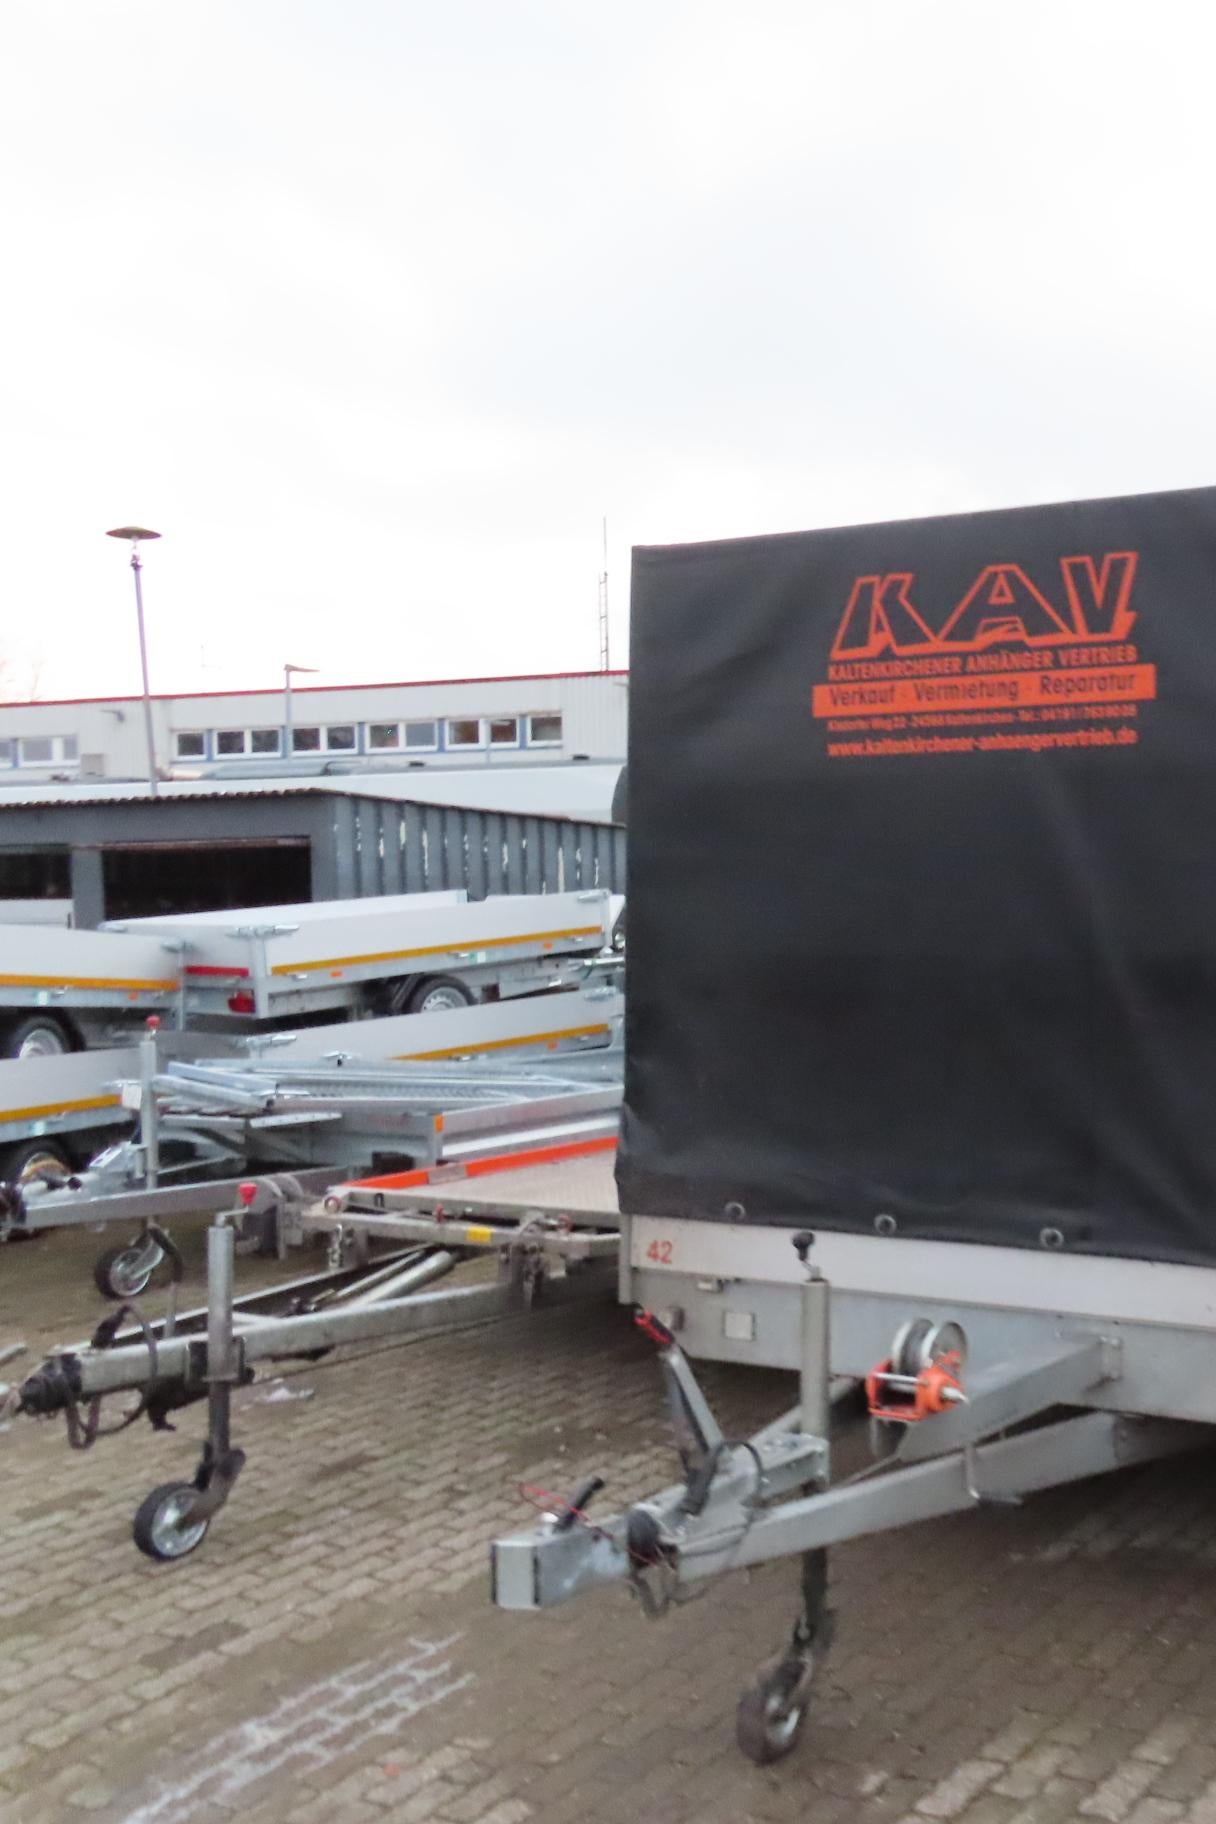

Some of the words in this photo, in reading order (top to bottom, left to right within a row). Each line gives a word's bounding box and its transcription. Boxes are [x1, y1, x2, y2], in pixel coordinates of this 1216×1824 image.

[830, 551, 1139, 661] KAV
[828, 656, 963, 681] KALTENKIRCHENER
[966, 650, 1053, 673] ANHÄNGER
[1057, 643, 1138, 667] VERTRIEB
[829, 685, 895, 707] Verkauf
[913, 680, 1019, 702] Vermietung
[1039, 673, 1136, 697] Reparatur
[646, 1240, 673, 1265] 42
